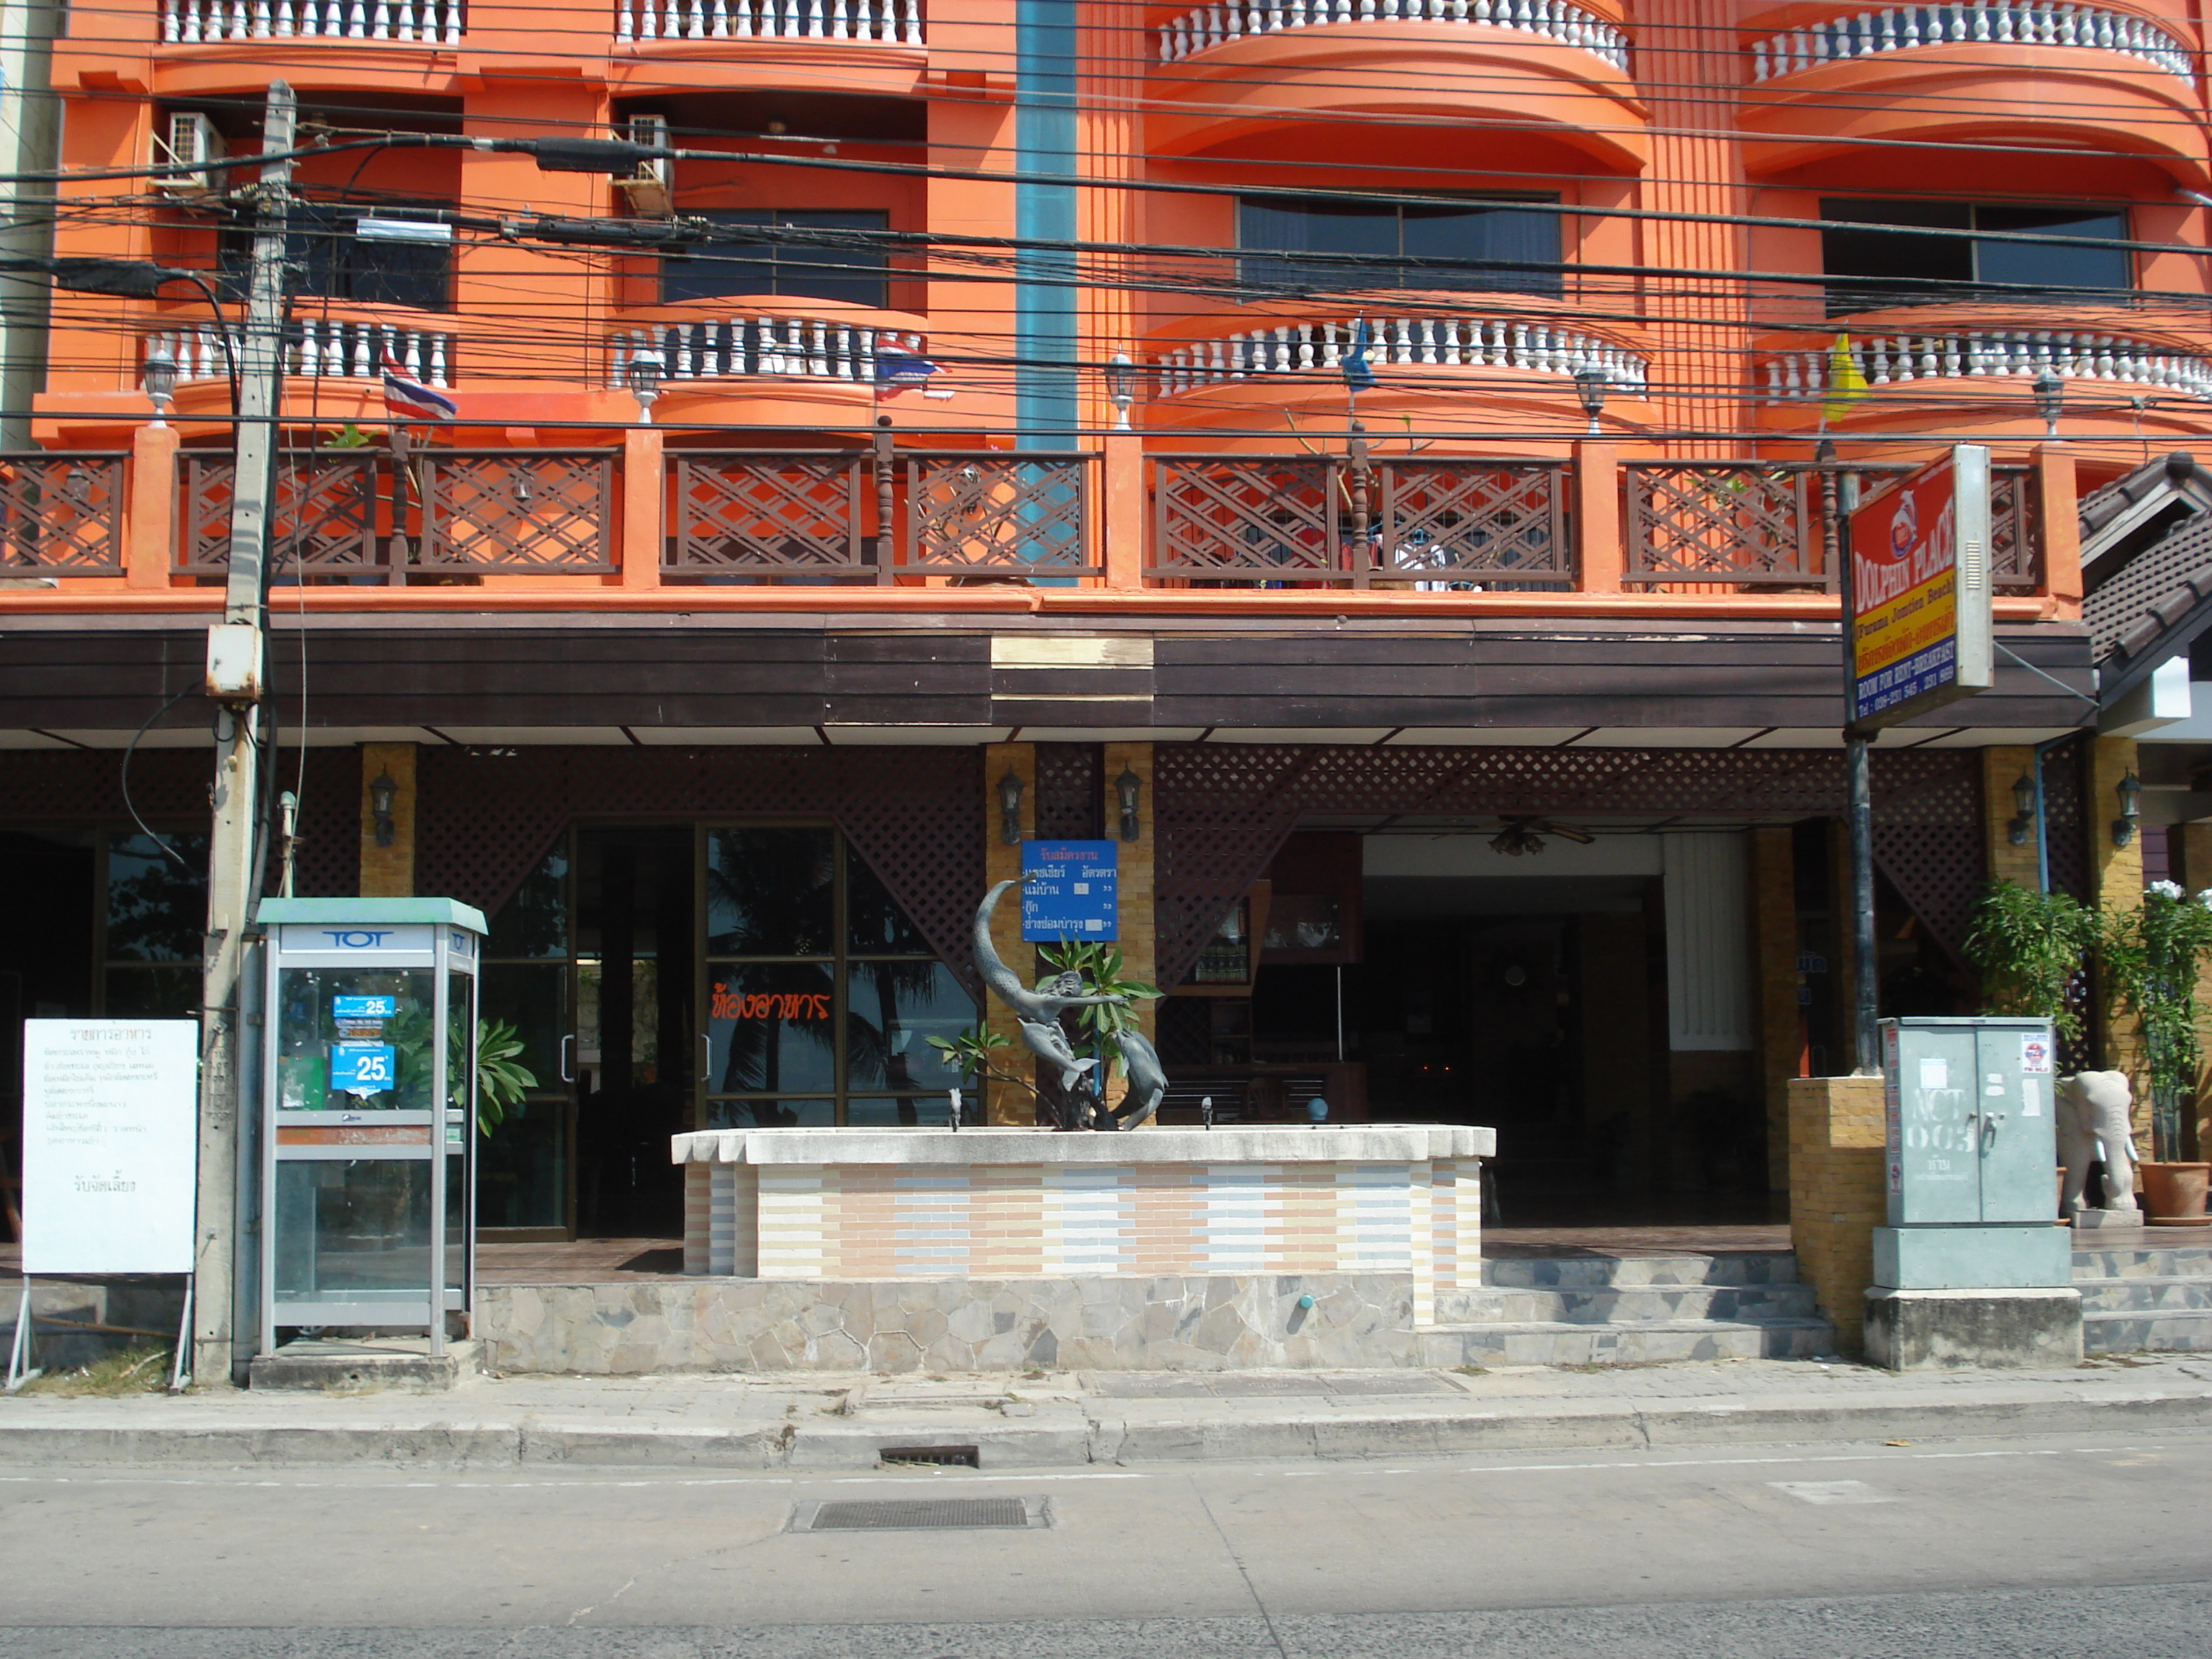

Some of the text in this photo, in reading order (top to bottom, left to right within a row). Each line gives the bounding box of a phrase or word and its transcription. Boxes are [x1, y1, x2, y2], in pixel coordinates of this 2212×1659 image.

[1854, 494, 1955, 613] DOLPHIN PLACE
[1891, 598, 1924, 623] Jomtien
[1858, 676, 1878, 701] ROOM
[1879, 670, 1894, 692] FOR
[1025, 881, 1059, 895] แม่บ้าน
[322, 931, 395, 948] TOT
[366, 1000, 385, 1014] 25
[711, 982, 830, 1020] ห้องอาหาร
[70, 1028, 151, 1041] รายการอาหาร
[356, 1056, 386, 1081] 25
[73, 1169, 135, 1192] รับจัดเลี้ยง
